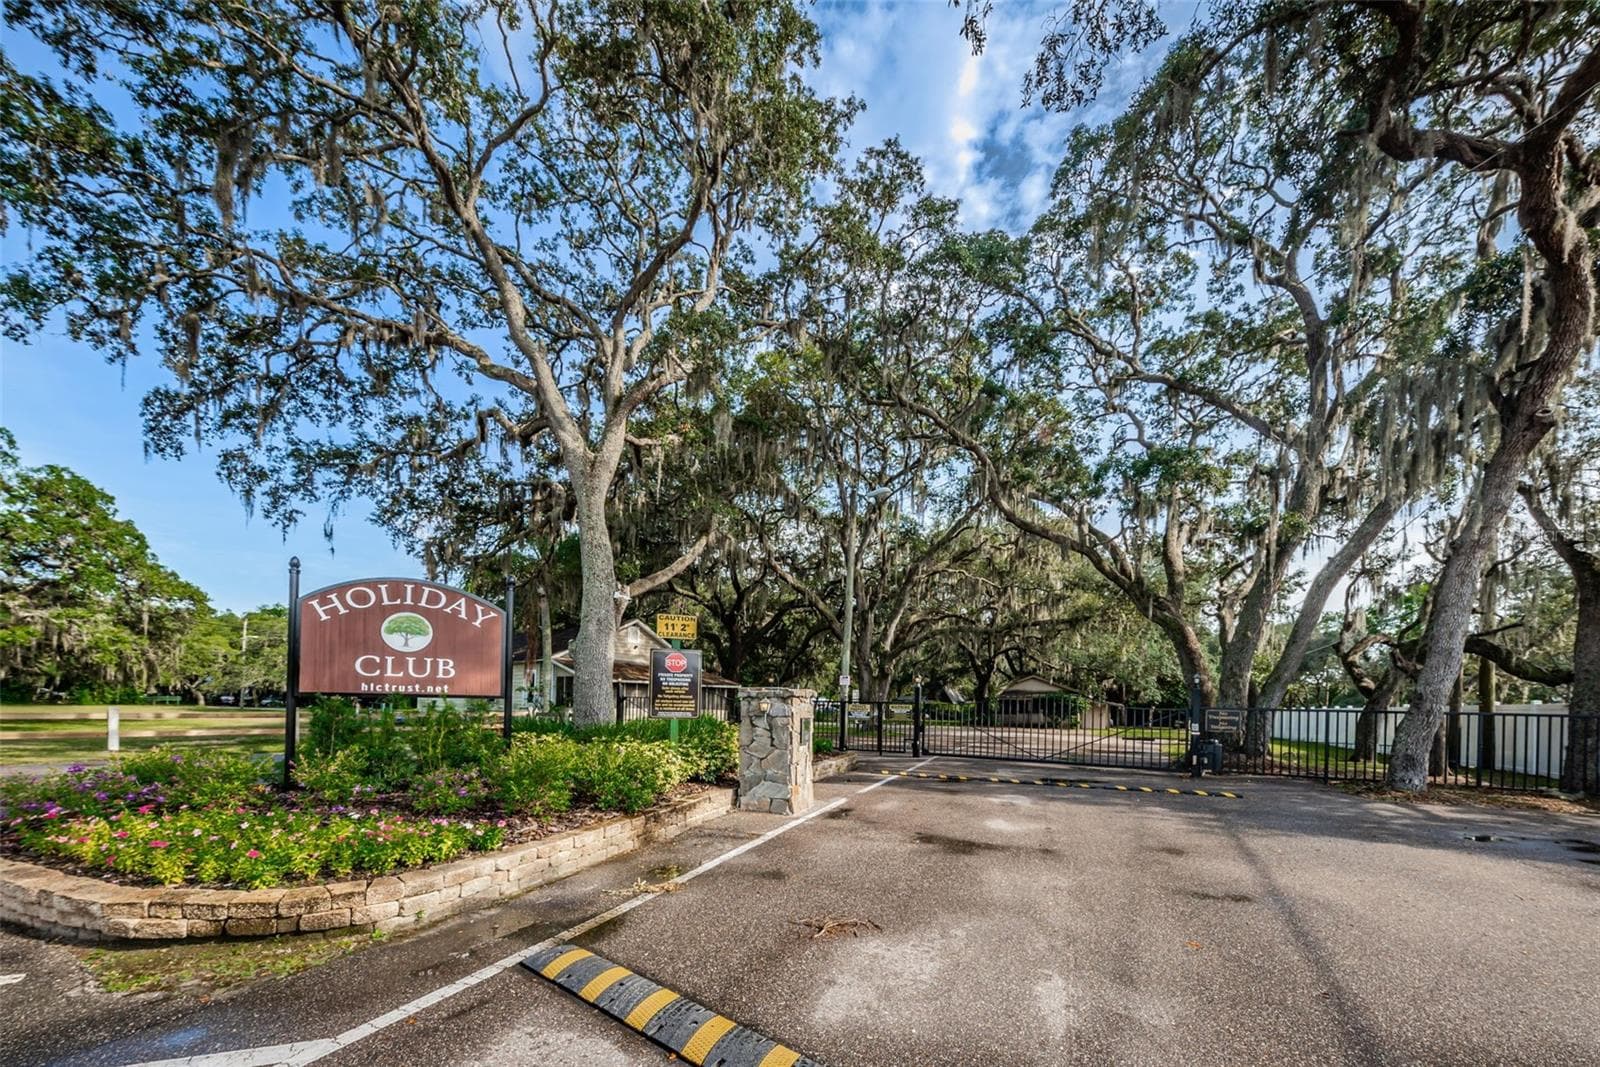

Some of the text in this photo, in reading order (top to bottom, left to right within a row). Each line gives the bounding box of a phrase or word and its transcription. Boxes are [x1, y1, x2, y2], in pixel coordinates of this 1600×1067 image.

[307, 584, 498, 628] HOLIDAY
[355, 655, 456, 678] CLUB
[665, 659, 687, 667] STOP
